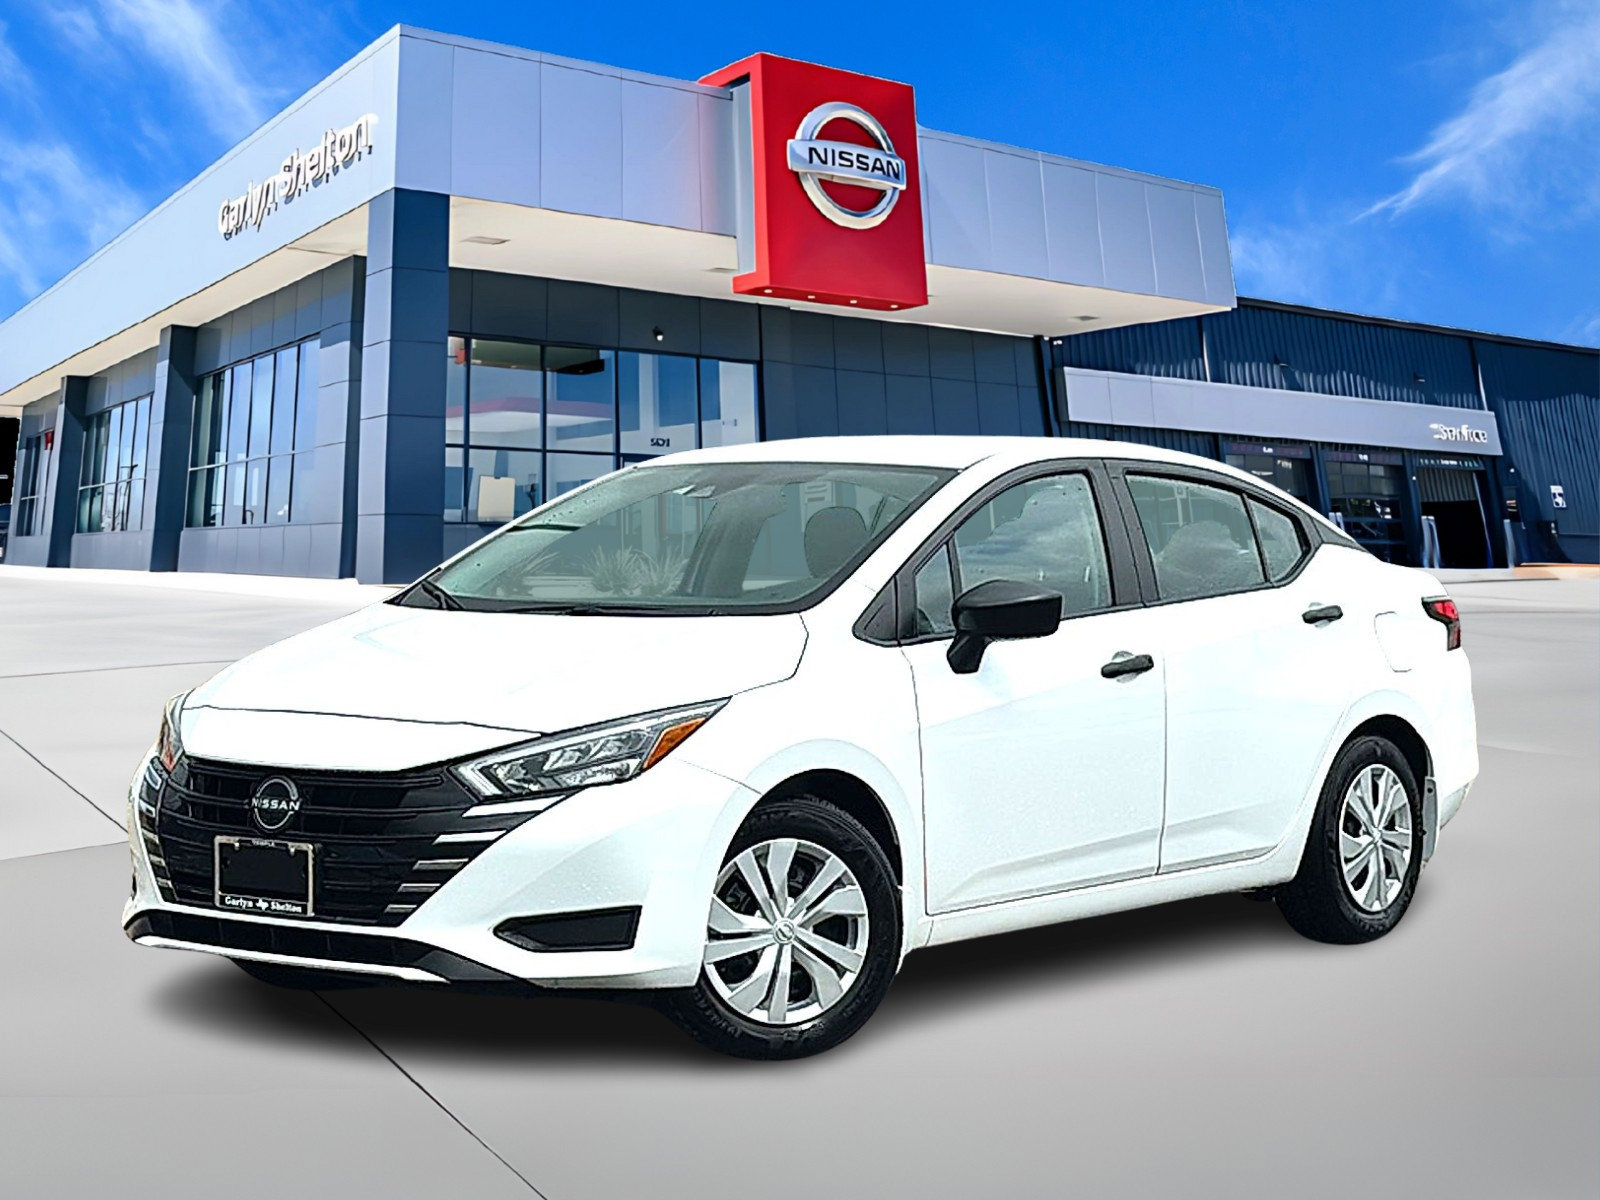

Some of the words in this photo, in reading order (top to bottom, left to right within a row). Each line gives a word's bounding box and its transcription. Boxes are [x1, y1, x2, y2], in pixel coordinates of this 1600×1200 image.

[278, 113, 377, 204] Shelton
[808, 146, 900, 180] NISSAN
[251, 797, 300, 811] NISSAN
[270, 901, 302, 913] Shelton
